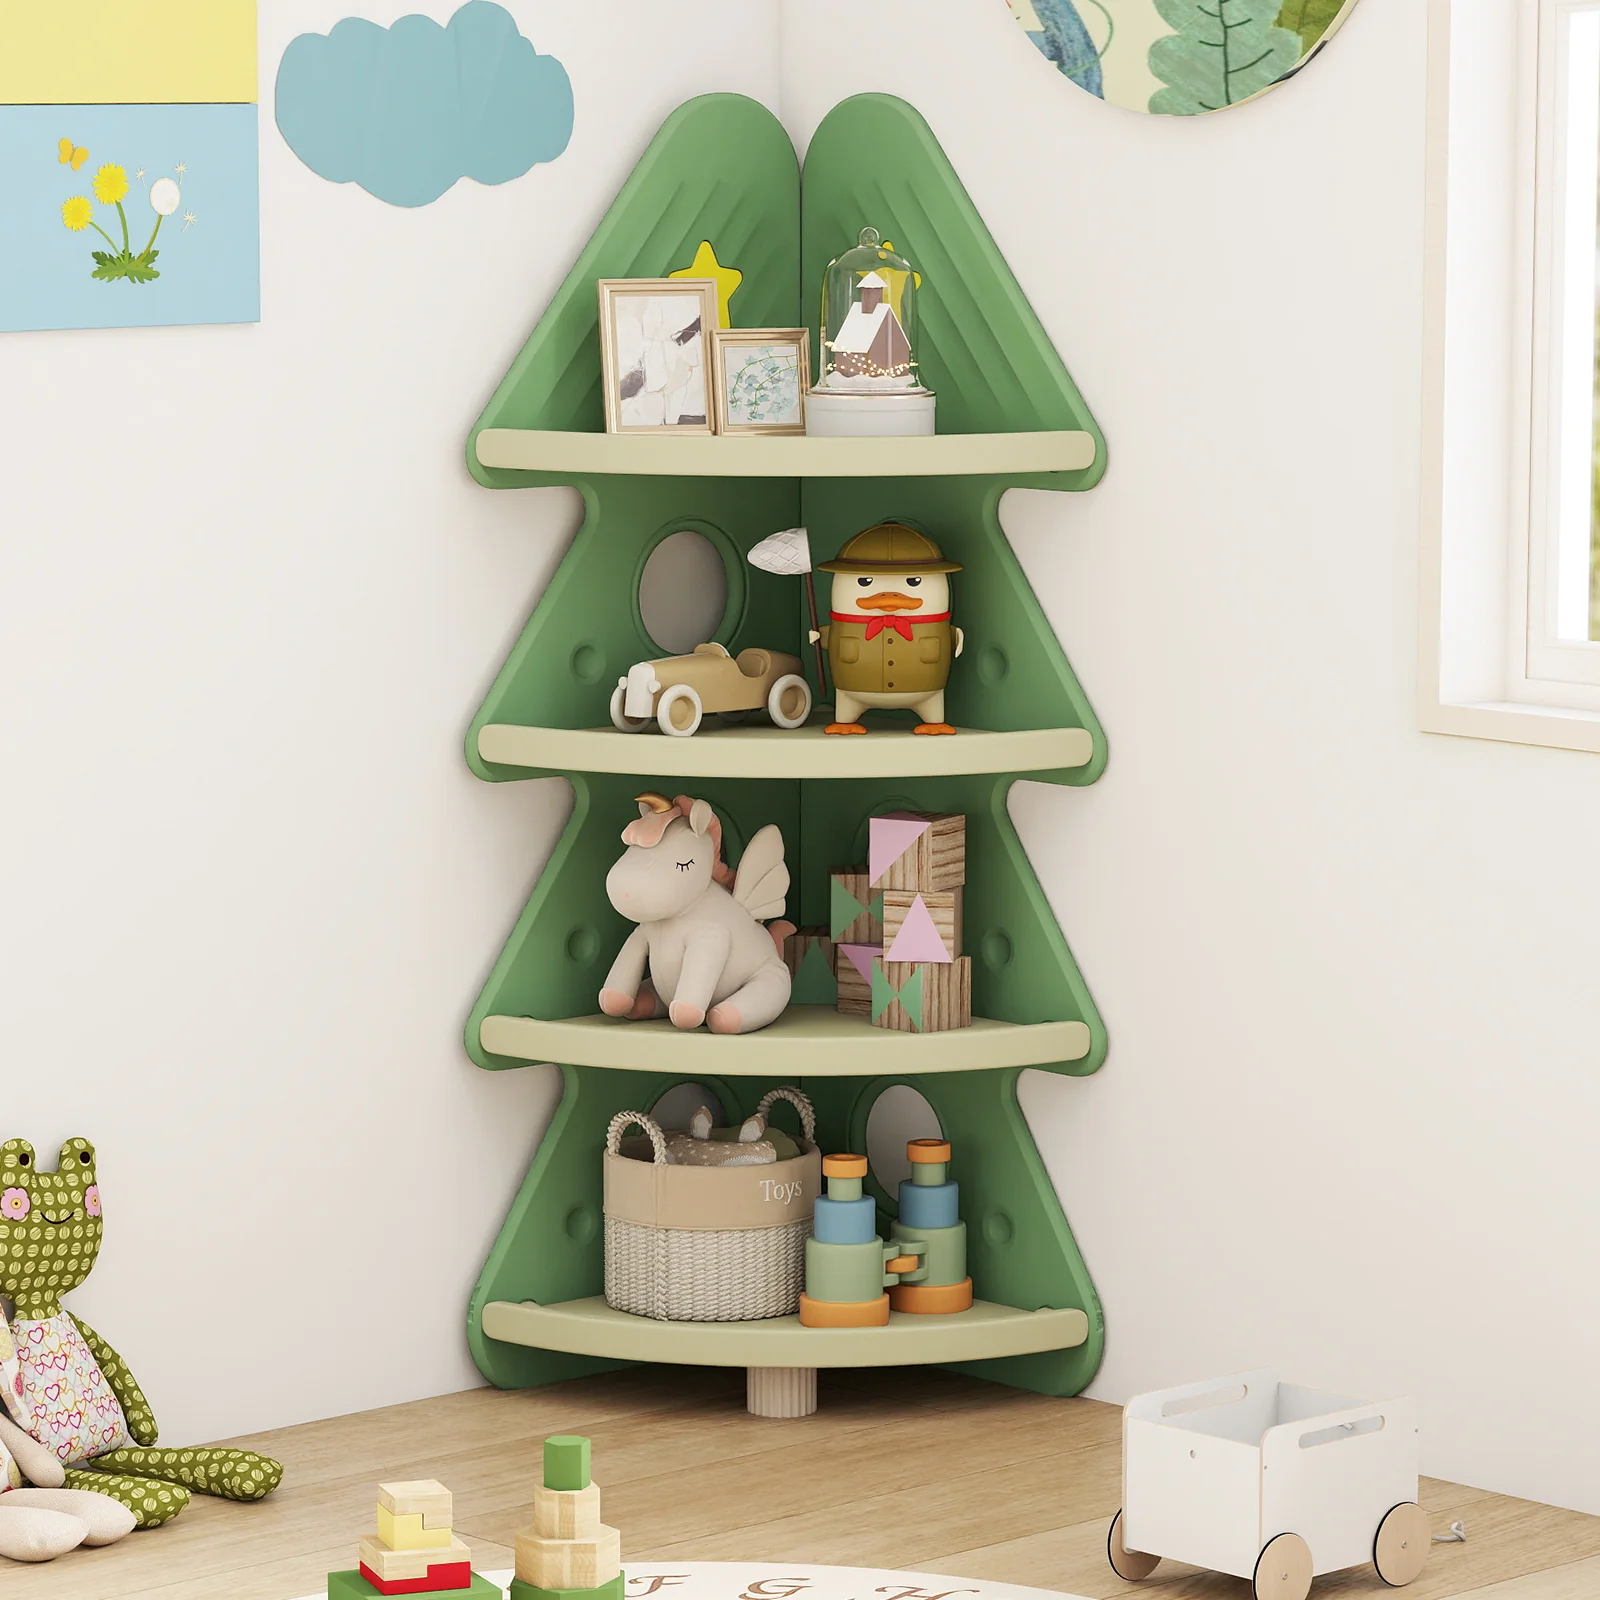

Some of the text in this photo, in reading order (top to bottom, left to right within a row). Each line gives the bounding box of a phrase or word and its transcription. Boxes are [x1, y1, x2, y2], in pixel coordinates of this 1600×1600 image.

[760, 1179, 803, 1205] Toys
[624, 1574, 692, 1598] F
[738, 1577, 815, 1600] G
